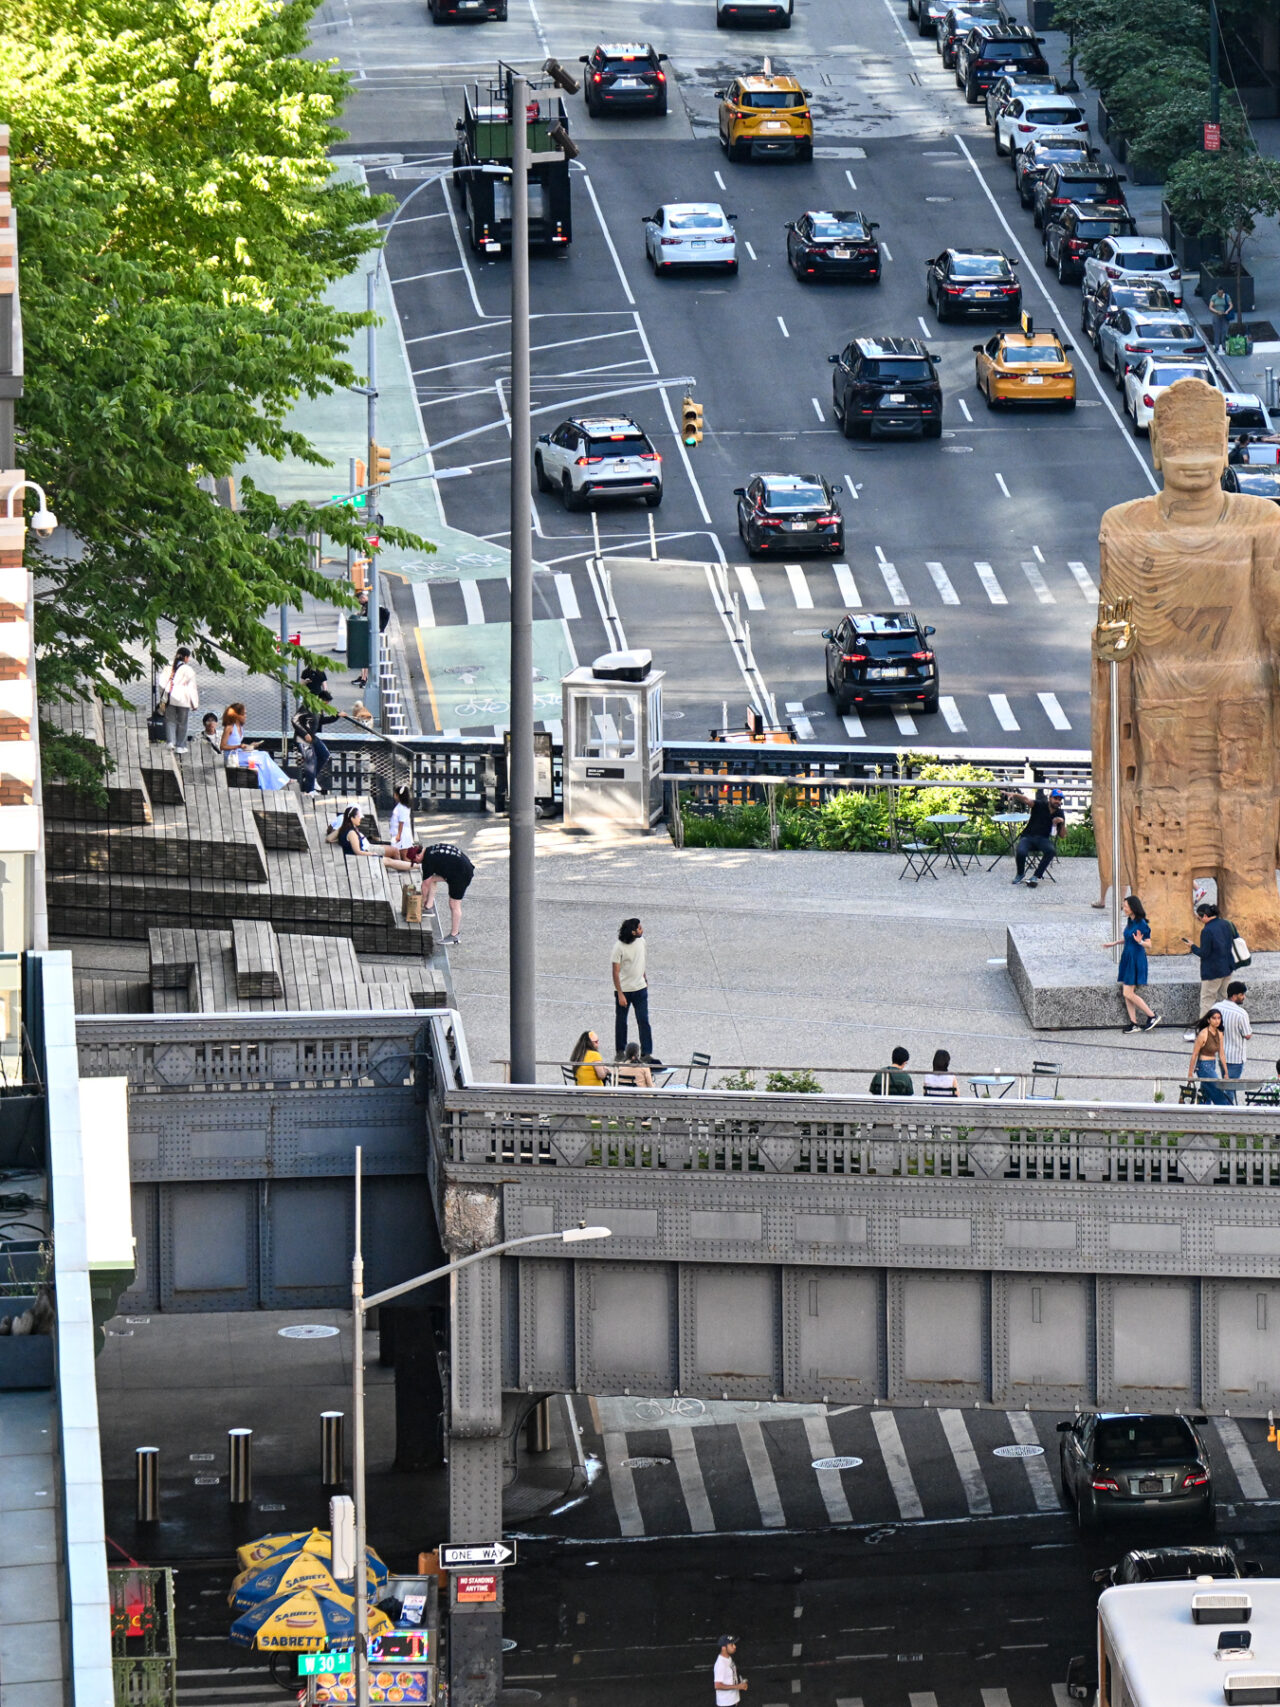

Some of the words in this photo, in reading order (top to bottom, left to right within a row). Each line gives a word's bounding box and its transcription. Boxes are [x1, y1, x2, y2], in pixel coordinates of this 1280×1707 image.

[451, 1550, 472, 1560] ONE
[483, 1549, 504, 1558] WAY
[275, 1611, 317, 1622] SABRETT
[262, 1636, 322, 1646] SABRETT
[305, 1657, 315, 1672] W
[319, 1656, 335, 1672] 30
